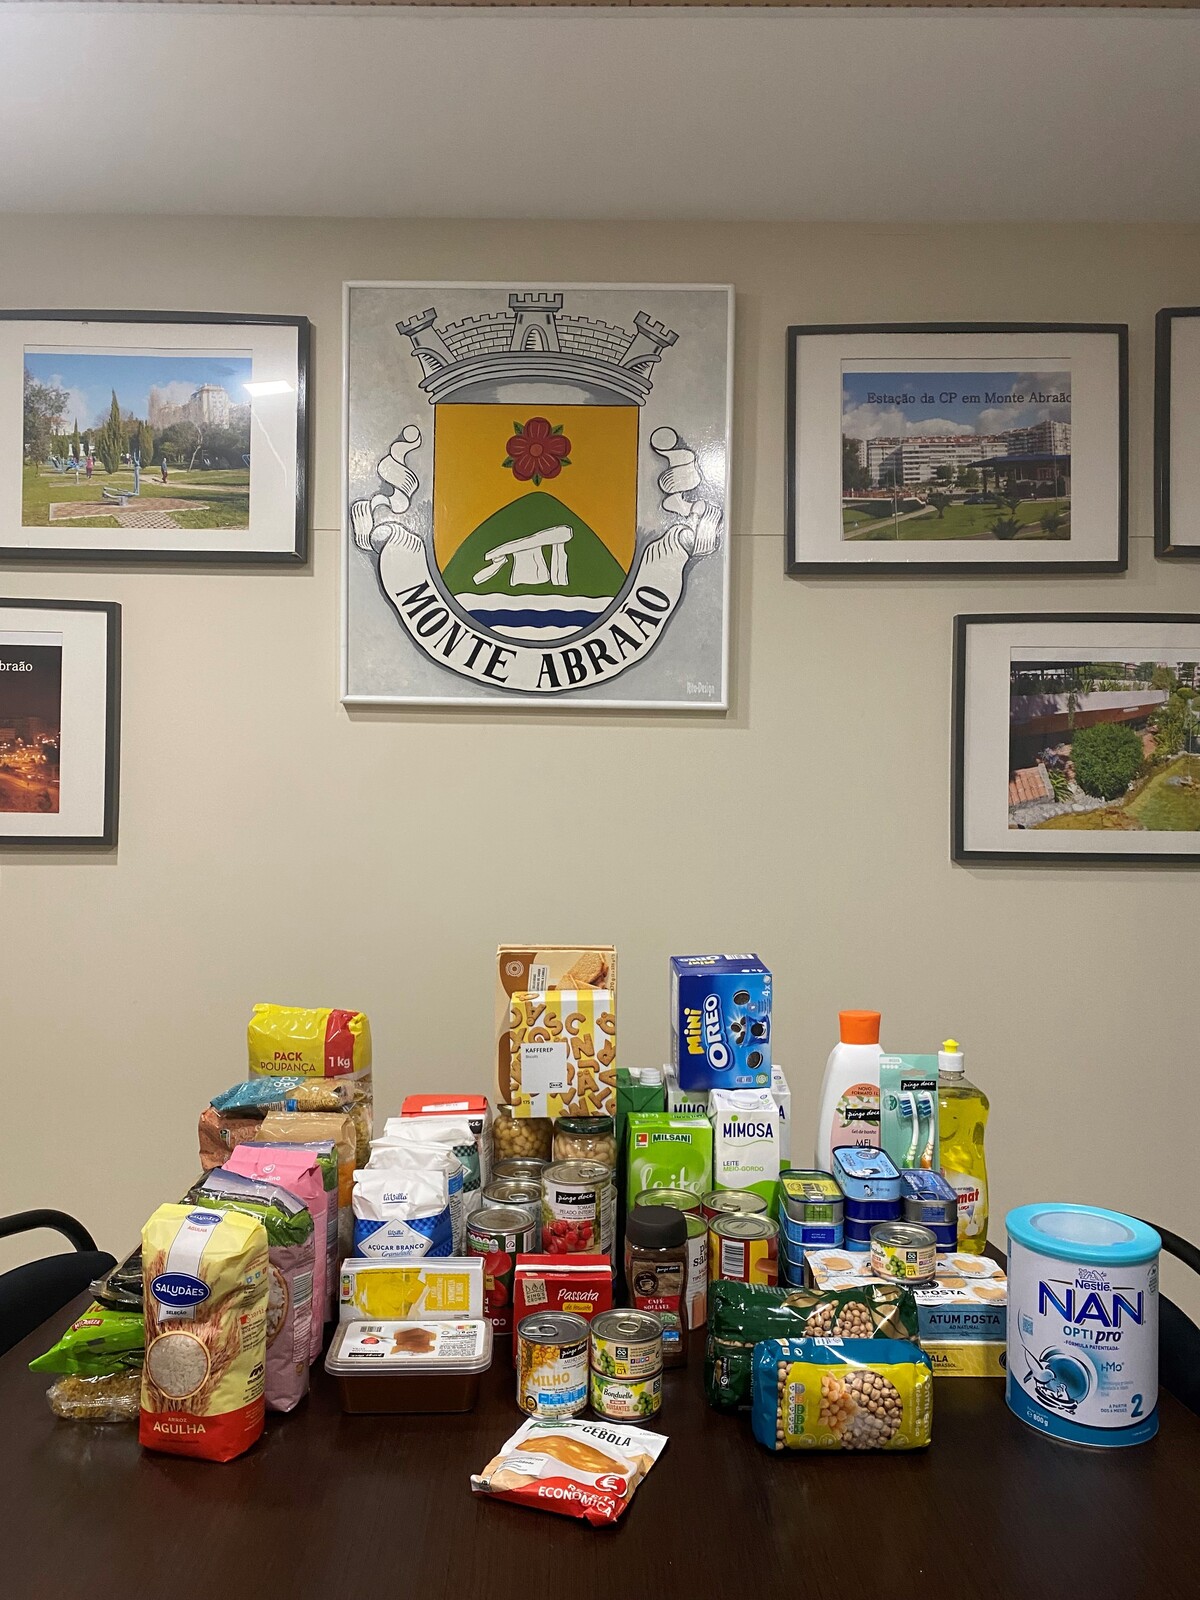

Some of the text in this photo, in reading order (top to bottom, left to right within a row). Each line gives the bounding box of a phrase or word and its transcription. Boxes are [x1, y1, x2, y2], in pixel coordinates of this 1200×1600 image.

[867, 392, 916, 405] Estação
[920, 392, 935, 403] da
[939, 392, 957, 403] CP
[962, 395, 980, 403] em
[984, 392, 1024, 403] Monte
[395, 580, 671, 689] MONTE ABRAÃO
[705, 995, 729, 1068] OREO
[274, 1051, 303, 1061] PACK
[328, 1056, 351, 1068] 1 kg
[260, 1061, 316, 1074] POUPANÇA
[903, 1082, 919, 1090] pingo
[847, 1111, 865, 1119] pingo
[723, 1123, 774, 1139] MIMOSA
[652, 1134, 691, 1143] MILSANI
[558, 1194, 576, 1203] pingo
[957, 1188, 979, 1204] mat
[367, 1243, 424, 1252] AÇÚCAR BRANCO
[155, 1283, 205, 1297] SALUDÃES
[1075, 1278, 1110, 1291] Nestlé
[557, 1288, 599, 1301] Passata
[1039, 1280, 1144, 1328] NAN
[929, 1314, 1000, 1324] ATUM POSTA
[1063, 1325, 1121, 1344] OPTI pro
[531, 1372, 570, 1387] MILHO
[604, 1388, 633, 1399] Bonduelle
[1130, 1393, 1144, 1418] 2
[153, 1421, 206, 1434] AGULHA
[582, 1426, 631, 1446] CEBOLA
